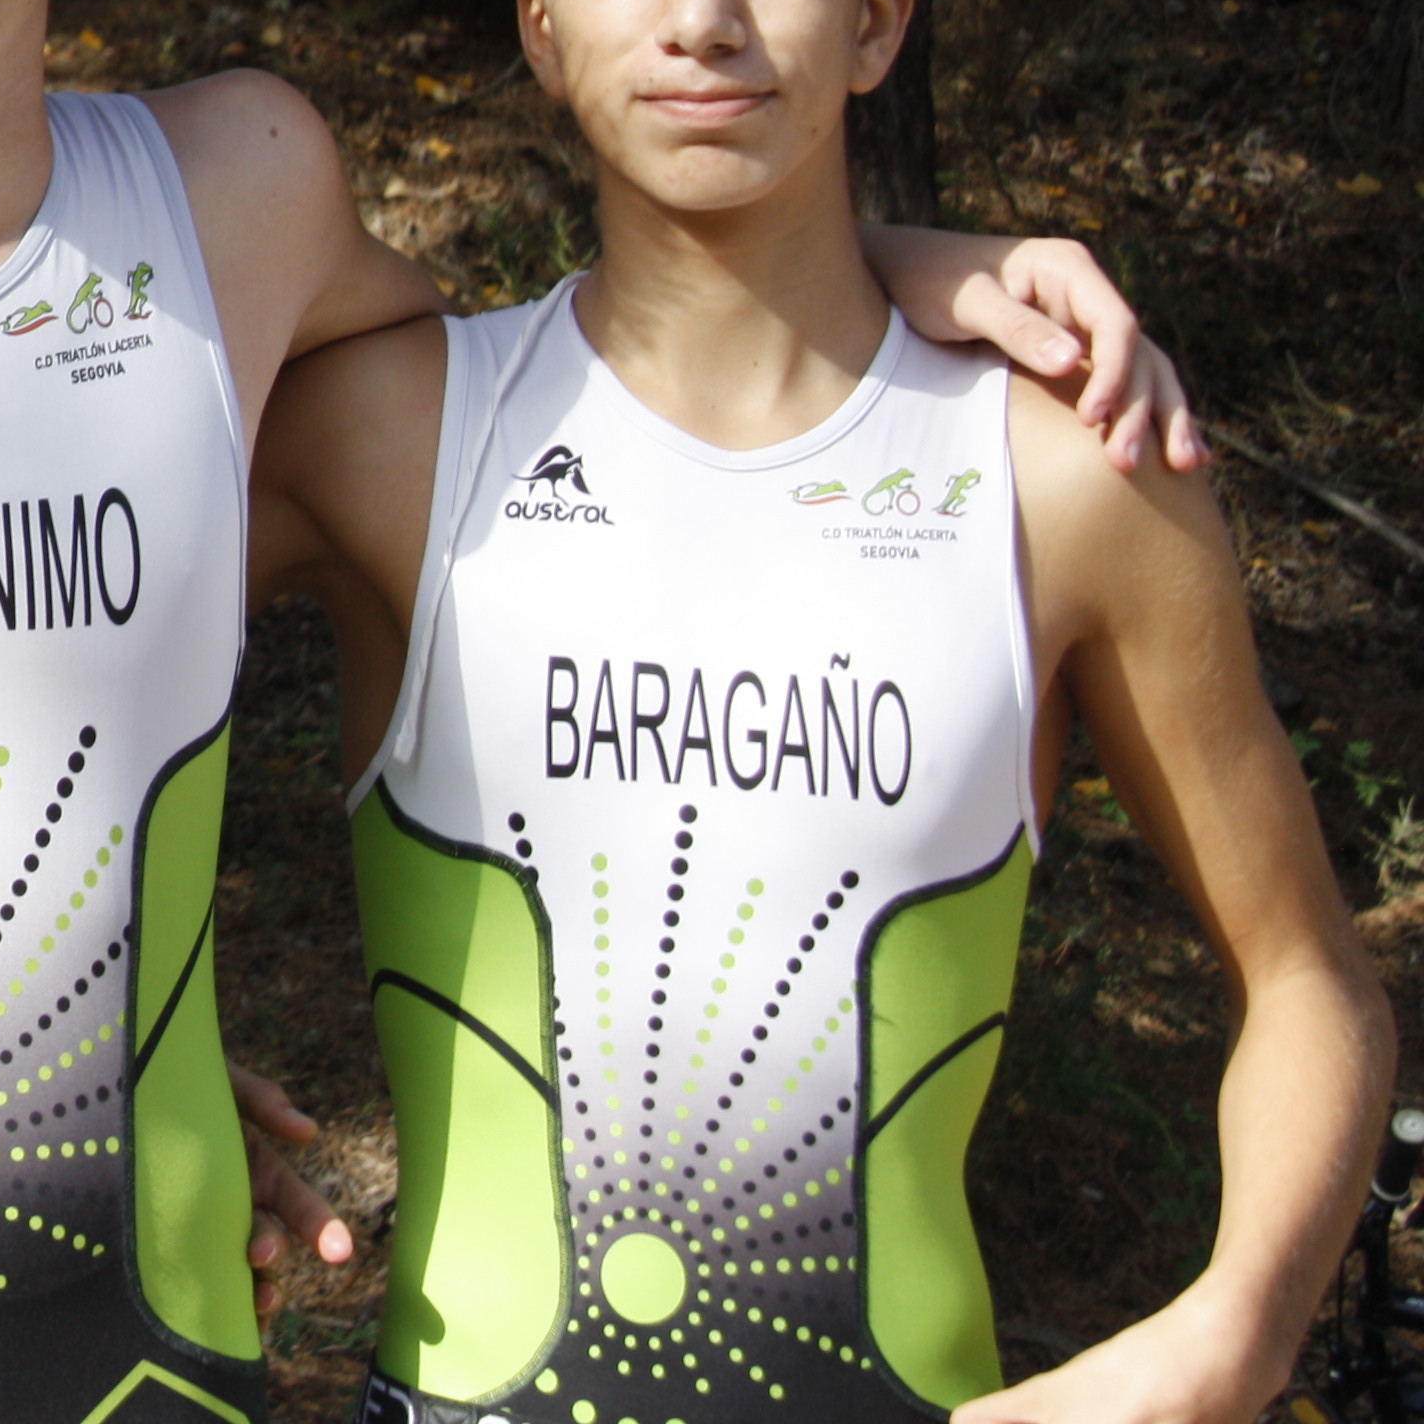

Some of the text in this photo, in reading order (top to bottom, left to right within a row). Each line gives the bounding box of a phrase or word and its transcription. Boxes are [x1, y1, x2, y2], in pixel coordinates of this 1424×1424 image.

[55, 341, 106, 366] TRIATLÓN
[108, 334, 152, 354] LACERTA
[71, 361, 126, 384] SEGOVIA
[505, 500, 615, 525] austral
[845, 526, 902, 540] TRIATLÓN
[906, 528, 958, 541] LACERTA
[860, 545, 920, 559] SEGOVIA
[544, 653, 911, 806] BARAGAÑO
